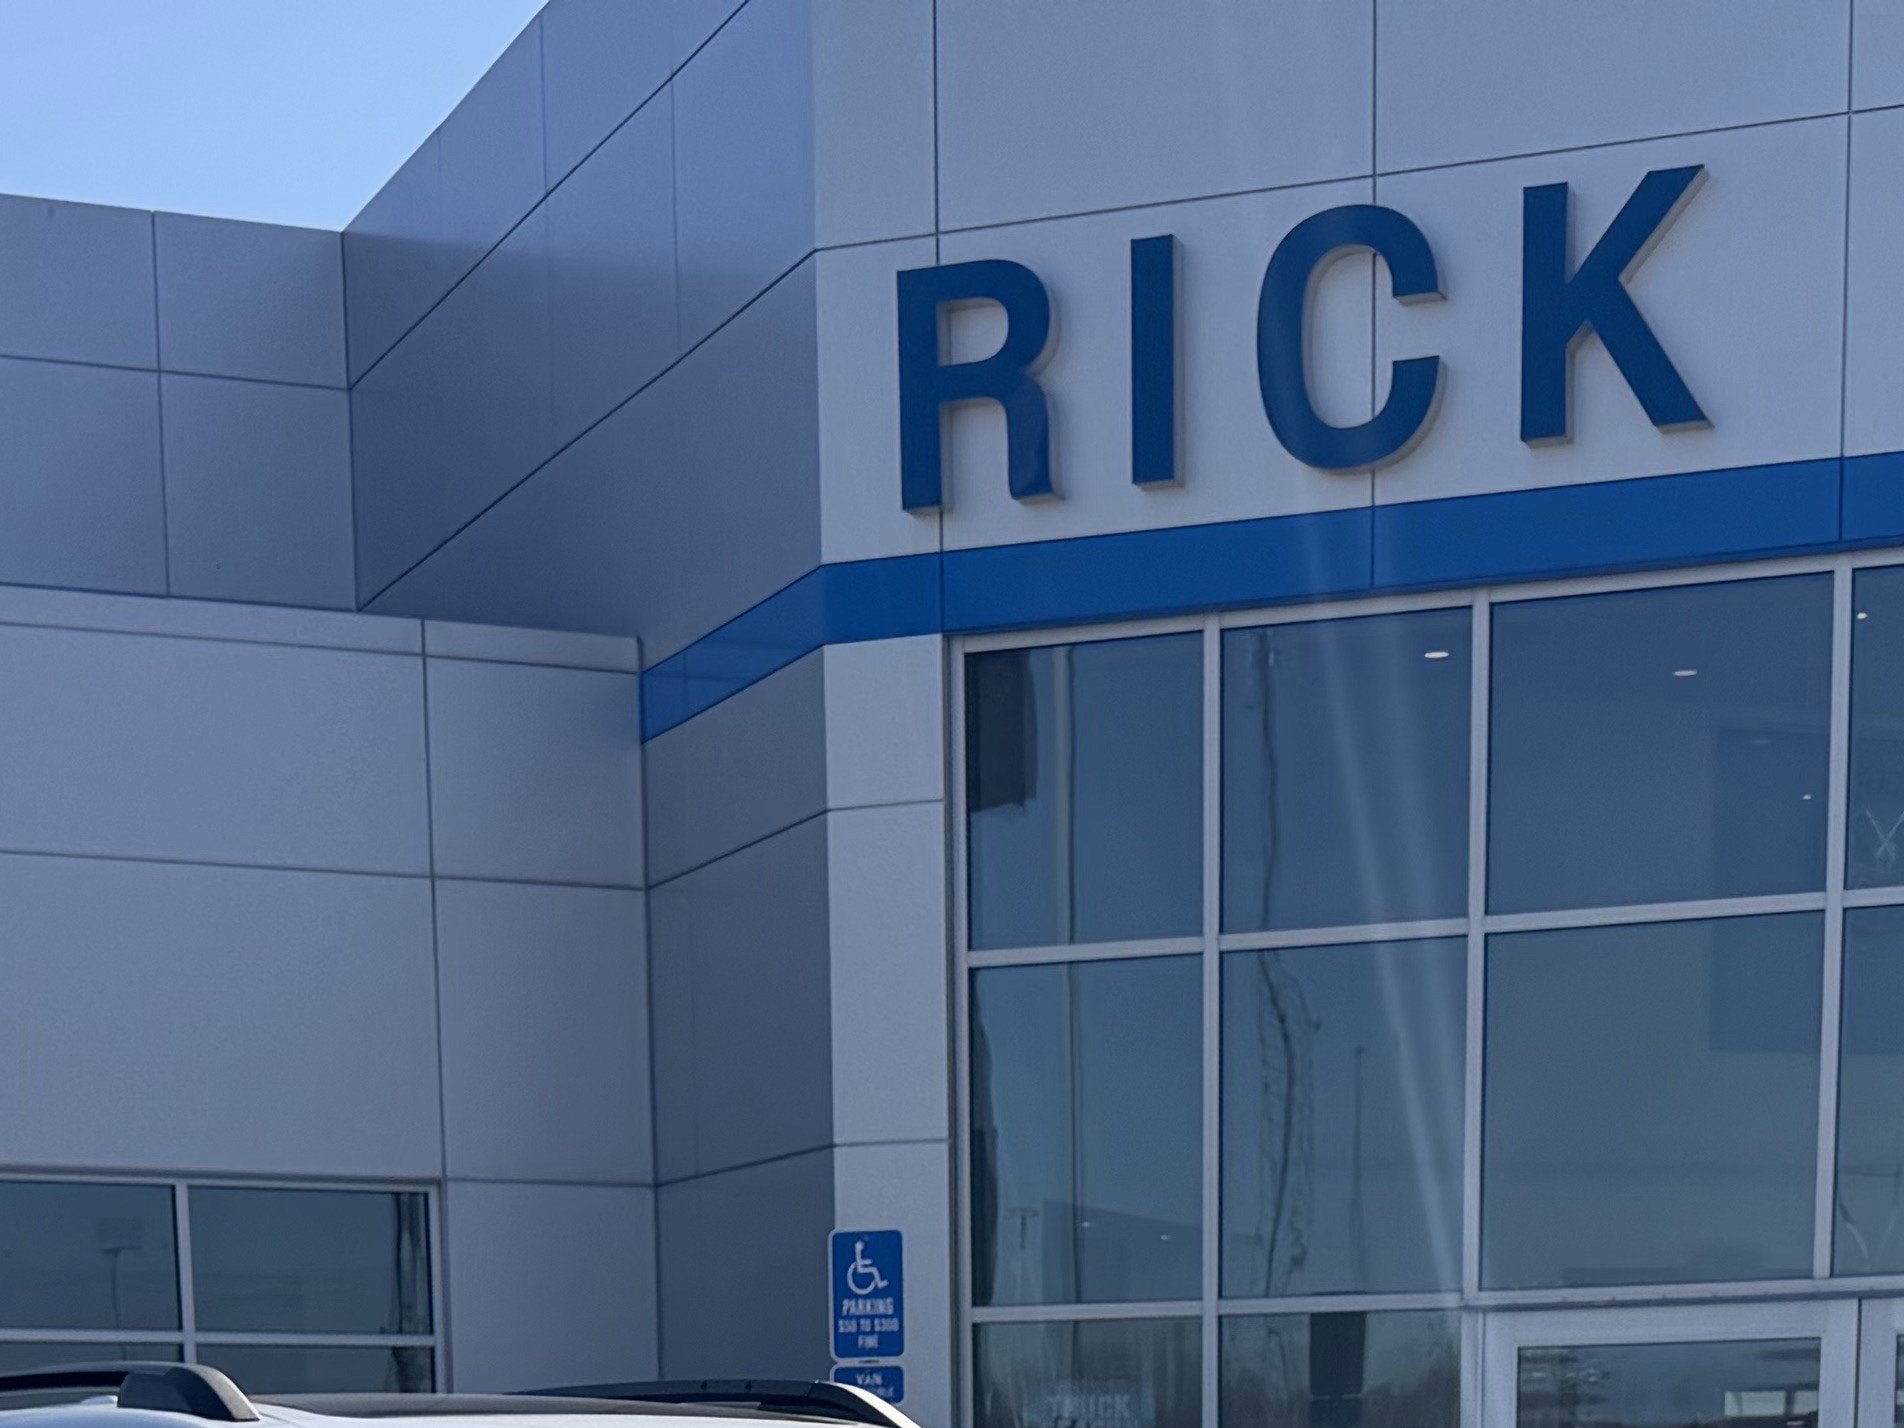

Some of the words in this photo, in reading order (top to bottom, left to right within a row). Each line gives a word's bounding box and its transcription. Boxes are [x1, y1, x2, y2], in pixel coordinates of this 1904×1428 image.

[896, 163, 1716, 516] RICK
[842, 1297, 894, 1316] PARKING
[856, 1372, 883, 1386] VAN
